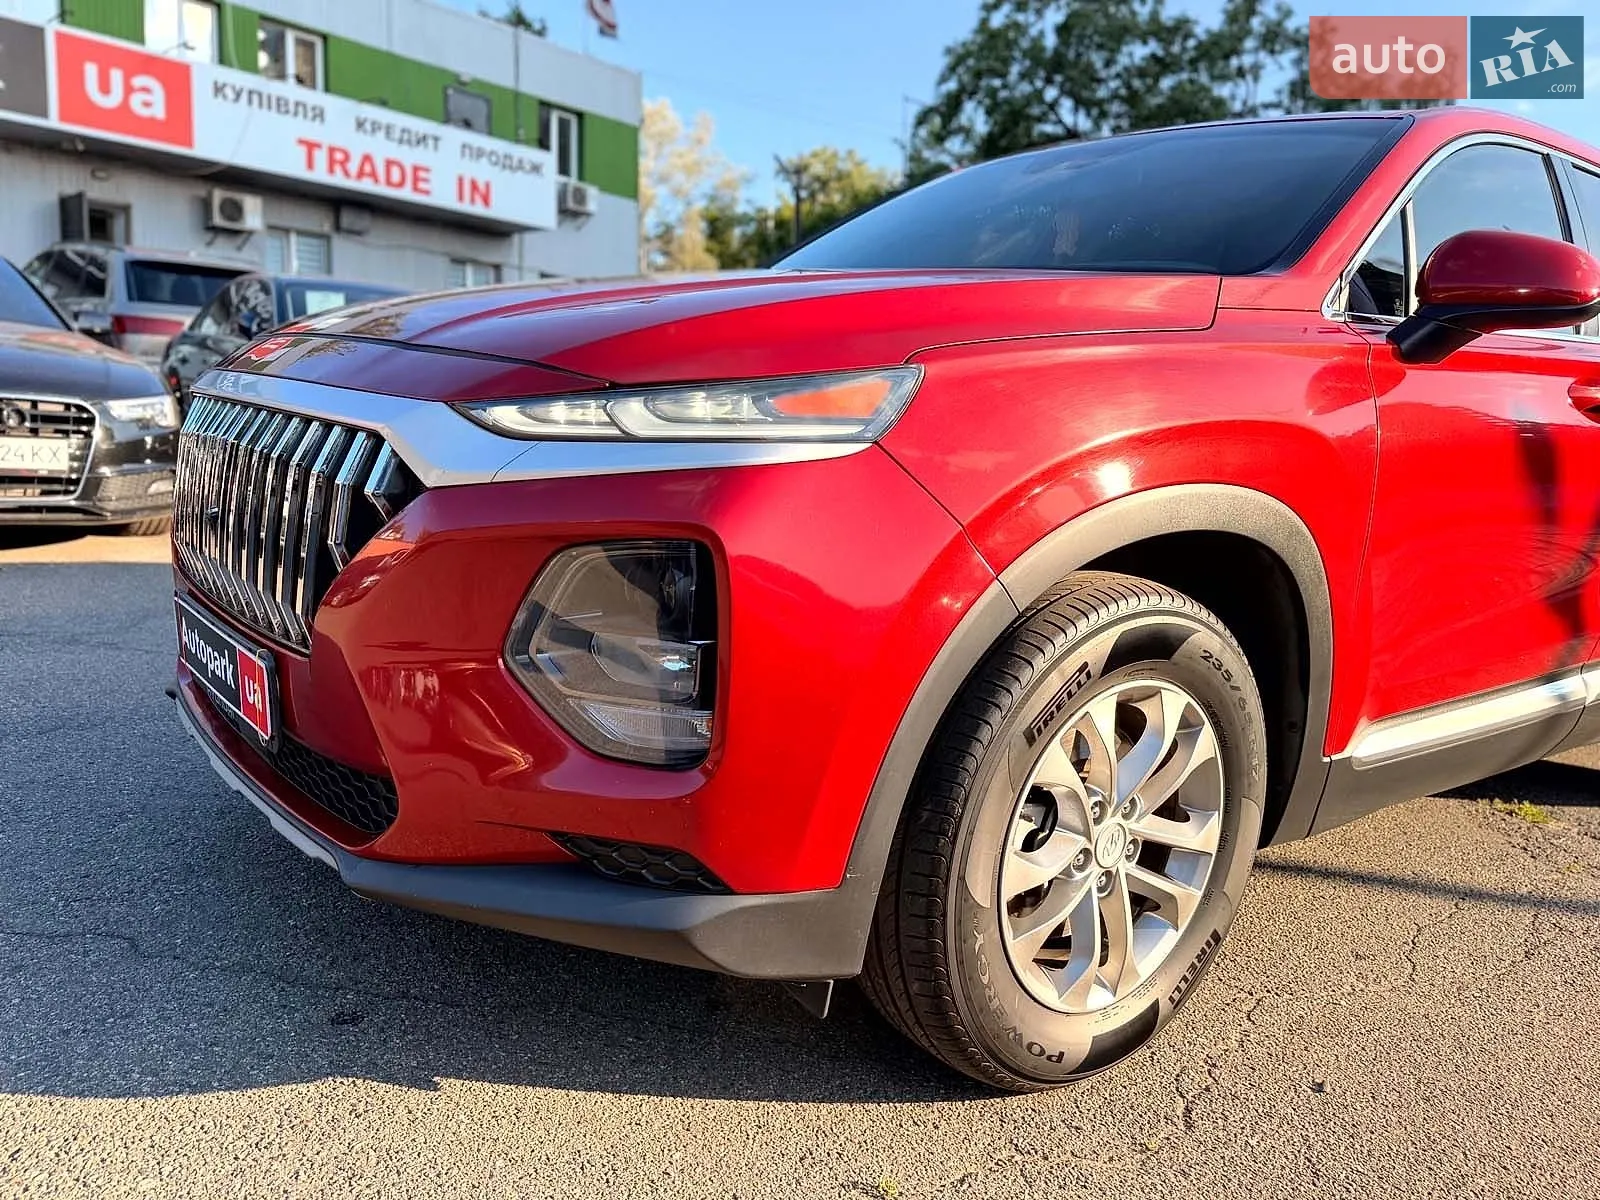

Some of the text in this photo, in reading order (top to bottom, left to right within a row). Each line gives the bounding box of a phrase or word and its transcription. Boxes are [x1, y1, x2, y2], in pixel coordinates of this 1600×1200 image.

[83, 60, 167, 122] ua
[212, 79, 545, 177] КУПІВЛЯ КРЕДИТ ПРОДАЖ
[296, 136, 492, 209] TRADE IN
[181, 616, 236, 690] Autopark
[244, 674, 263, 713] ua
[1022, 660, 1092, 749] PIRELLI
[1167, 927, 1223, 1010] PIRELLI
